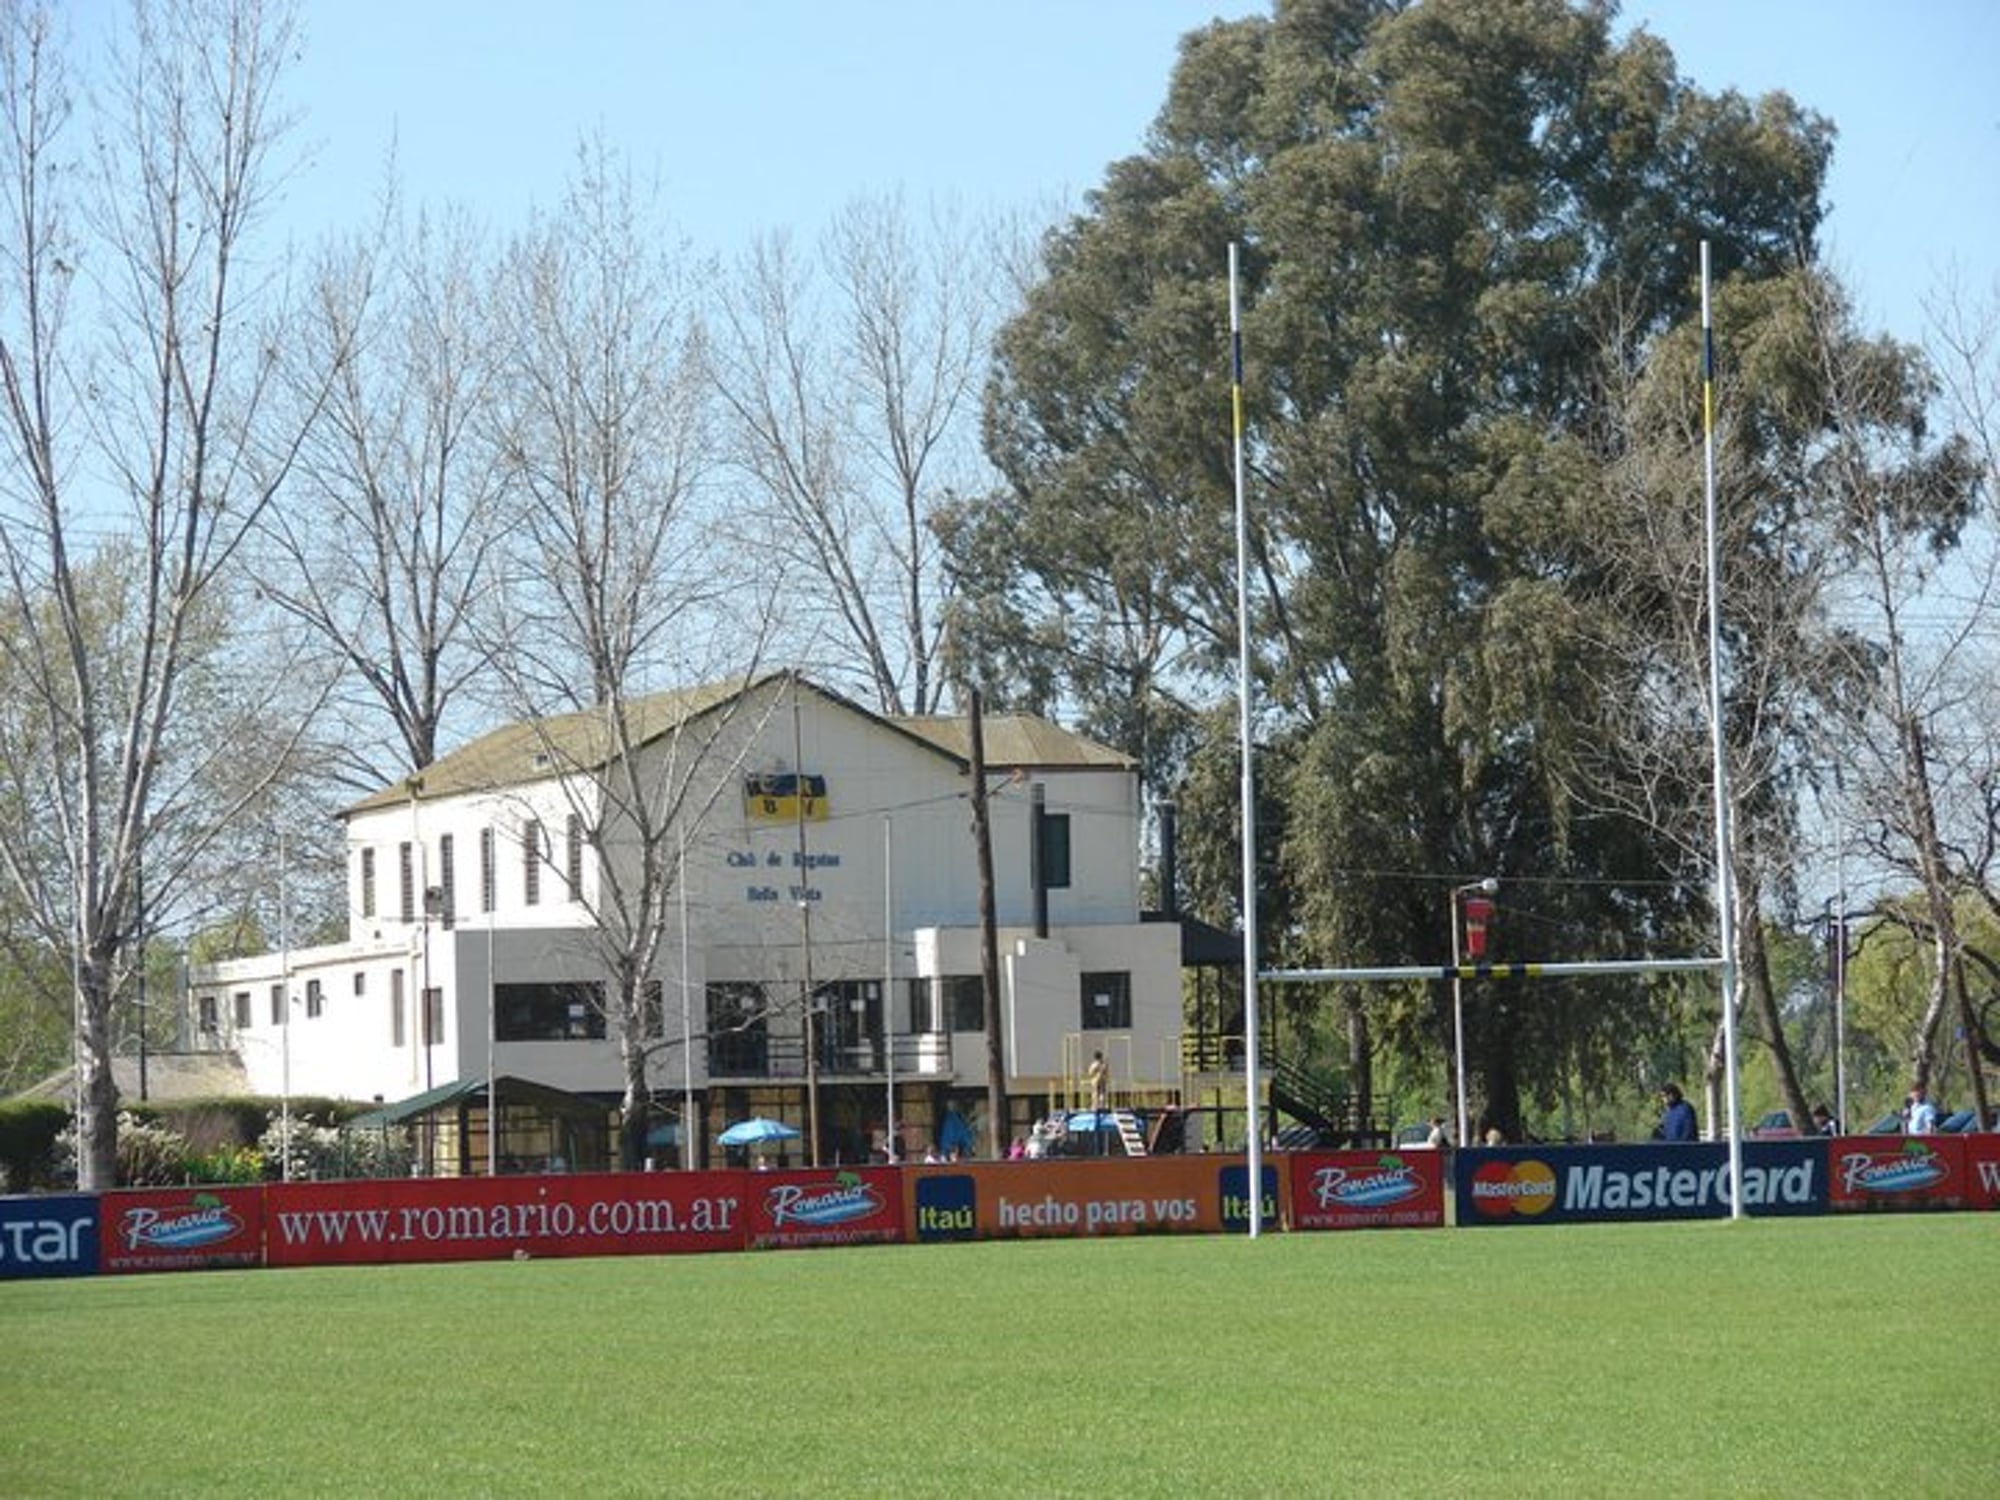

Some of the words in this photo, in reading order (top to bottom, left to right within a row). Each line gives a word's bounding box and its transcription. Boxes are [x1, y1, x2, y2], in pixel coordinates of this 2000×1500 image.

[766, 852, 781, 867] de
[1472, 1178, 1557, 1198] MasterCard
[277, 1186, 738, 1245] www.romario.com.ar
[919, 1205, 974, 1230] Itaú
[999, 1197, 1076, 1227] hecho
[1086, 1197, 1147, 1232] para
[1153, 1197, 1197, 1220] vos
[0, 1217, 93, 1263] tar
